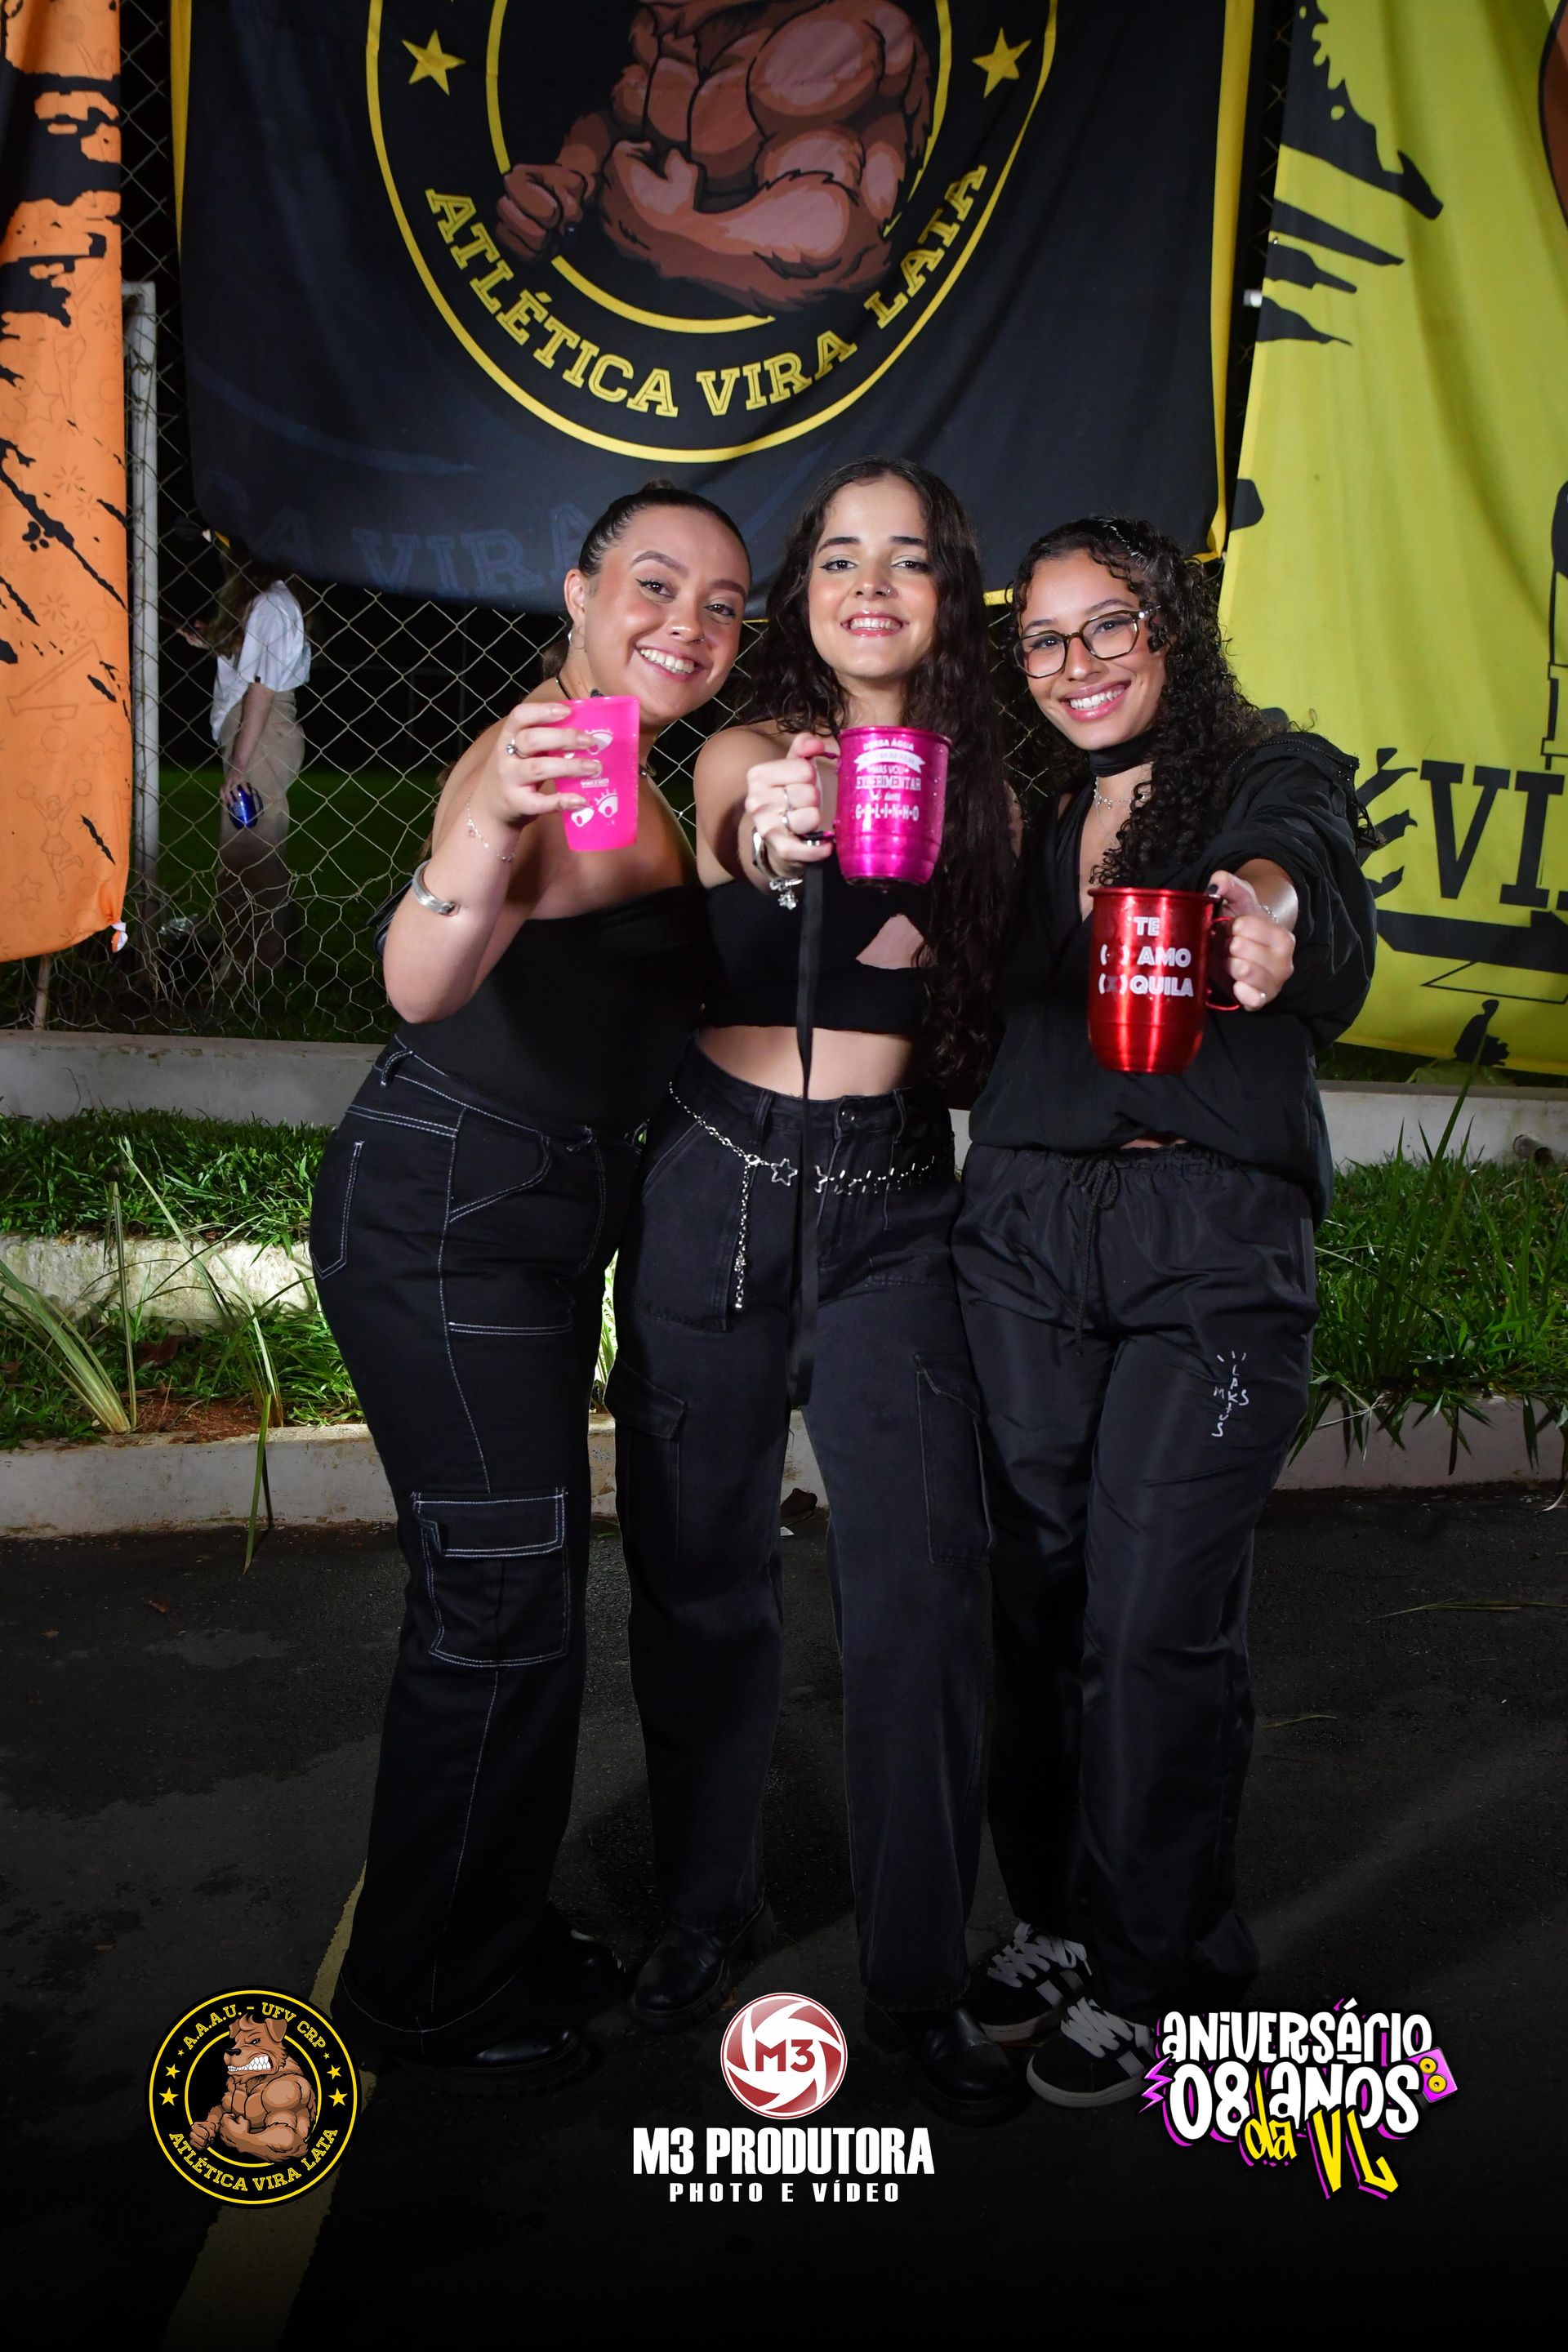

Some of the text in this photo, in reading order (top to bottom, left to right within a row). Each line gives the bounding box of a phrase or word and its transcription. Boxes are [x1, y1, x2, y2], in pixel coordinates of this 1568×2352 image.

[426, 164, 987, 419] ATLÉTICA VIRA LATA
[1420, 760, 1568, 910] VI
[1133, 916, 1161, 937] TE
[1137, 946, 1192, 968] AMO
